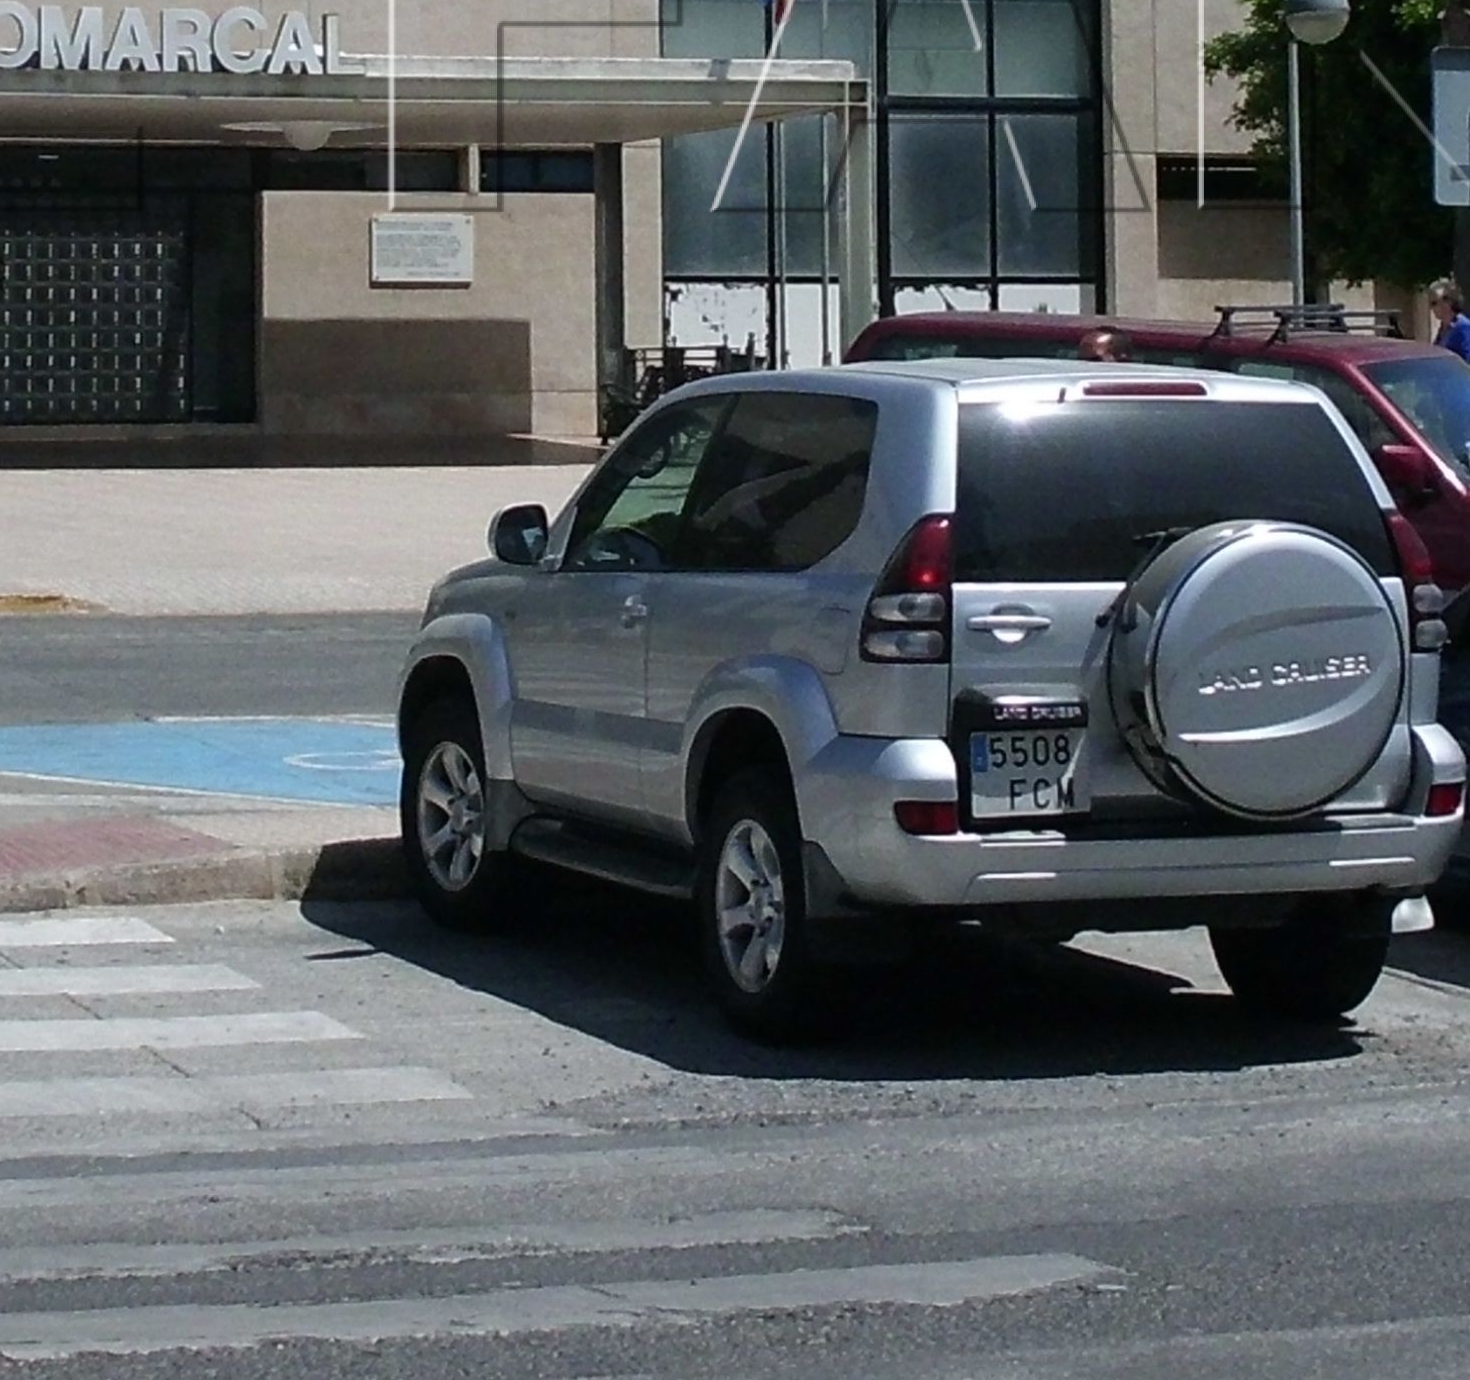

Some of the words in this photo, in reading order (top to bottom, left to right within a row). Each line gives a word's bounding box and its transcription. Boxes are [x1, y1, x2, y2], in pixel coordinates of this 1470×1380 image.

[1198, 667, 1262, 695] LAND
[1271, 655, 1371, 686] CRUISER
[993, 706, 1028, 720] LAND
[1031, 705, 1082, 719] CRUISER
[990, 734, 1070, 768] 5508
[1010, 777, 1074, 810] FCM
